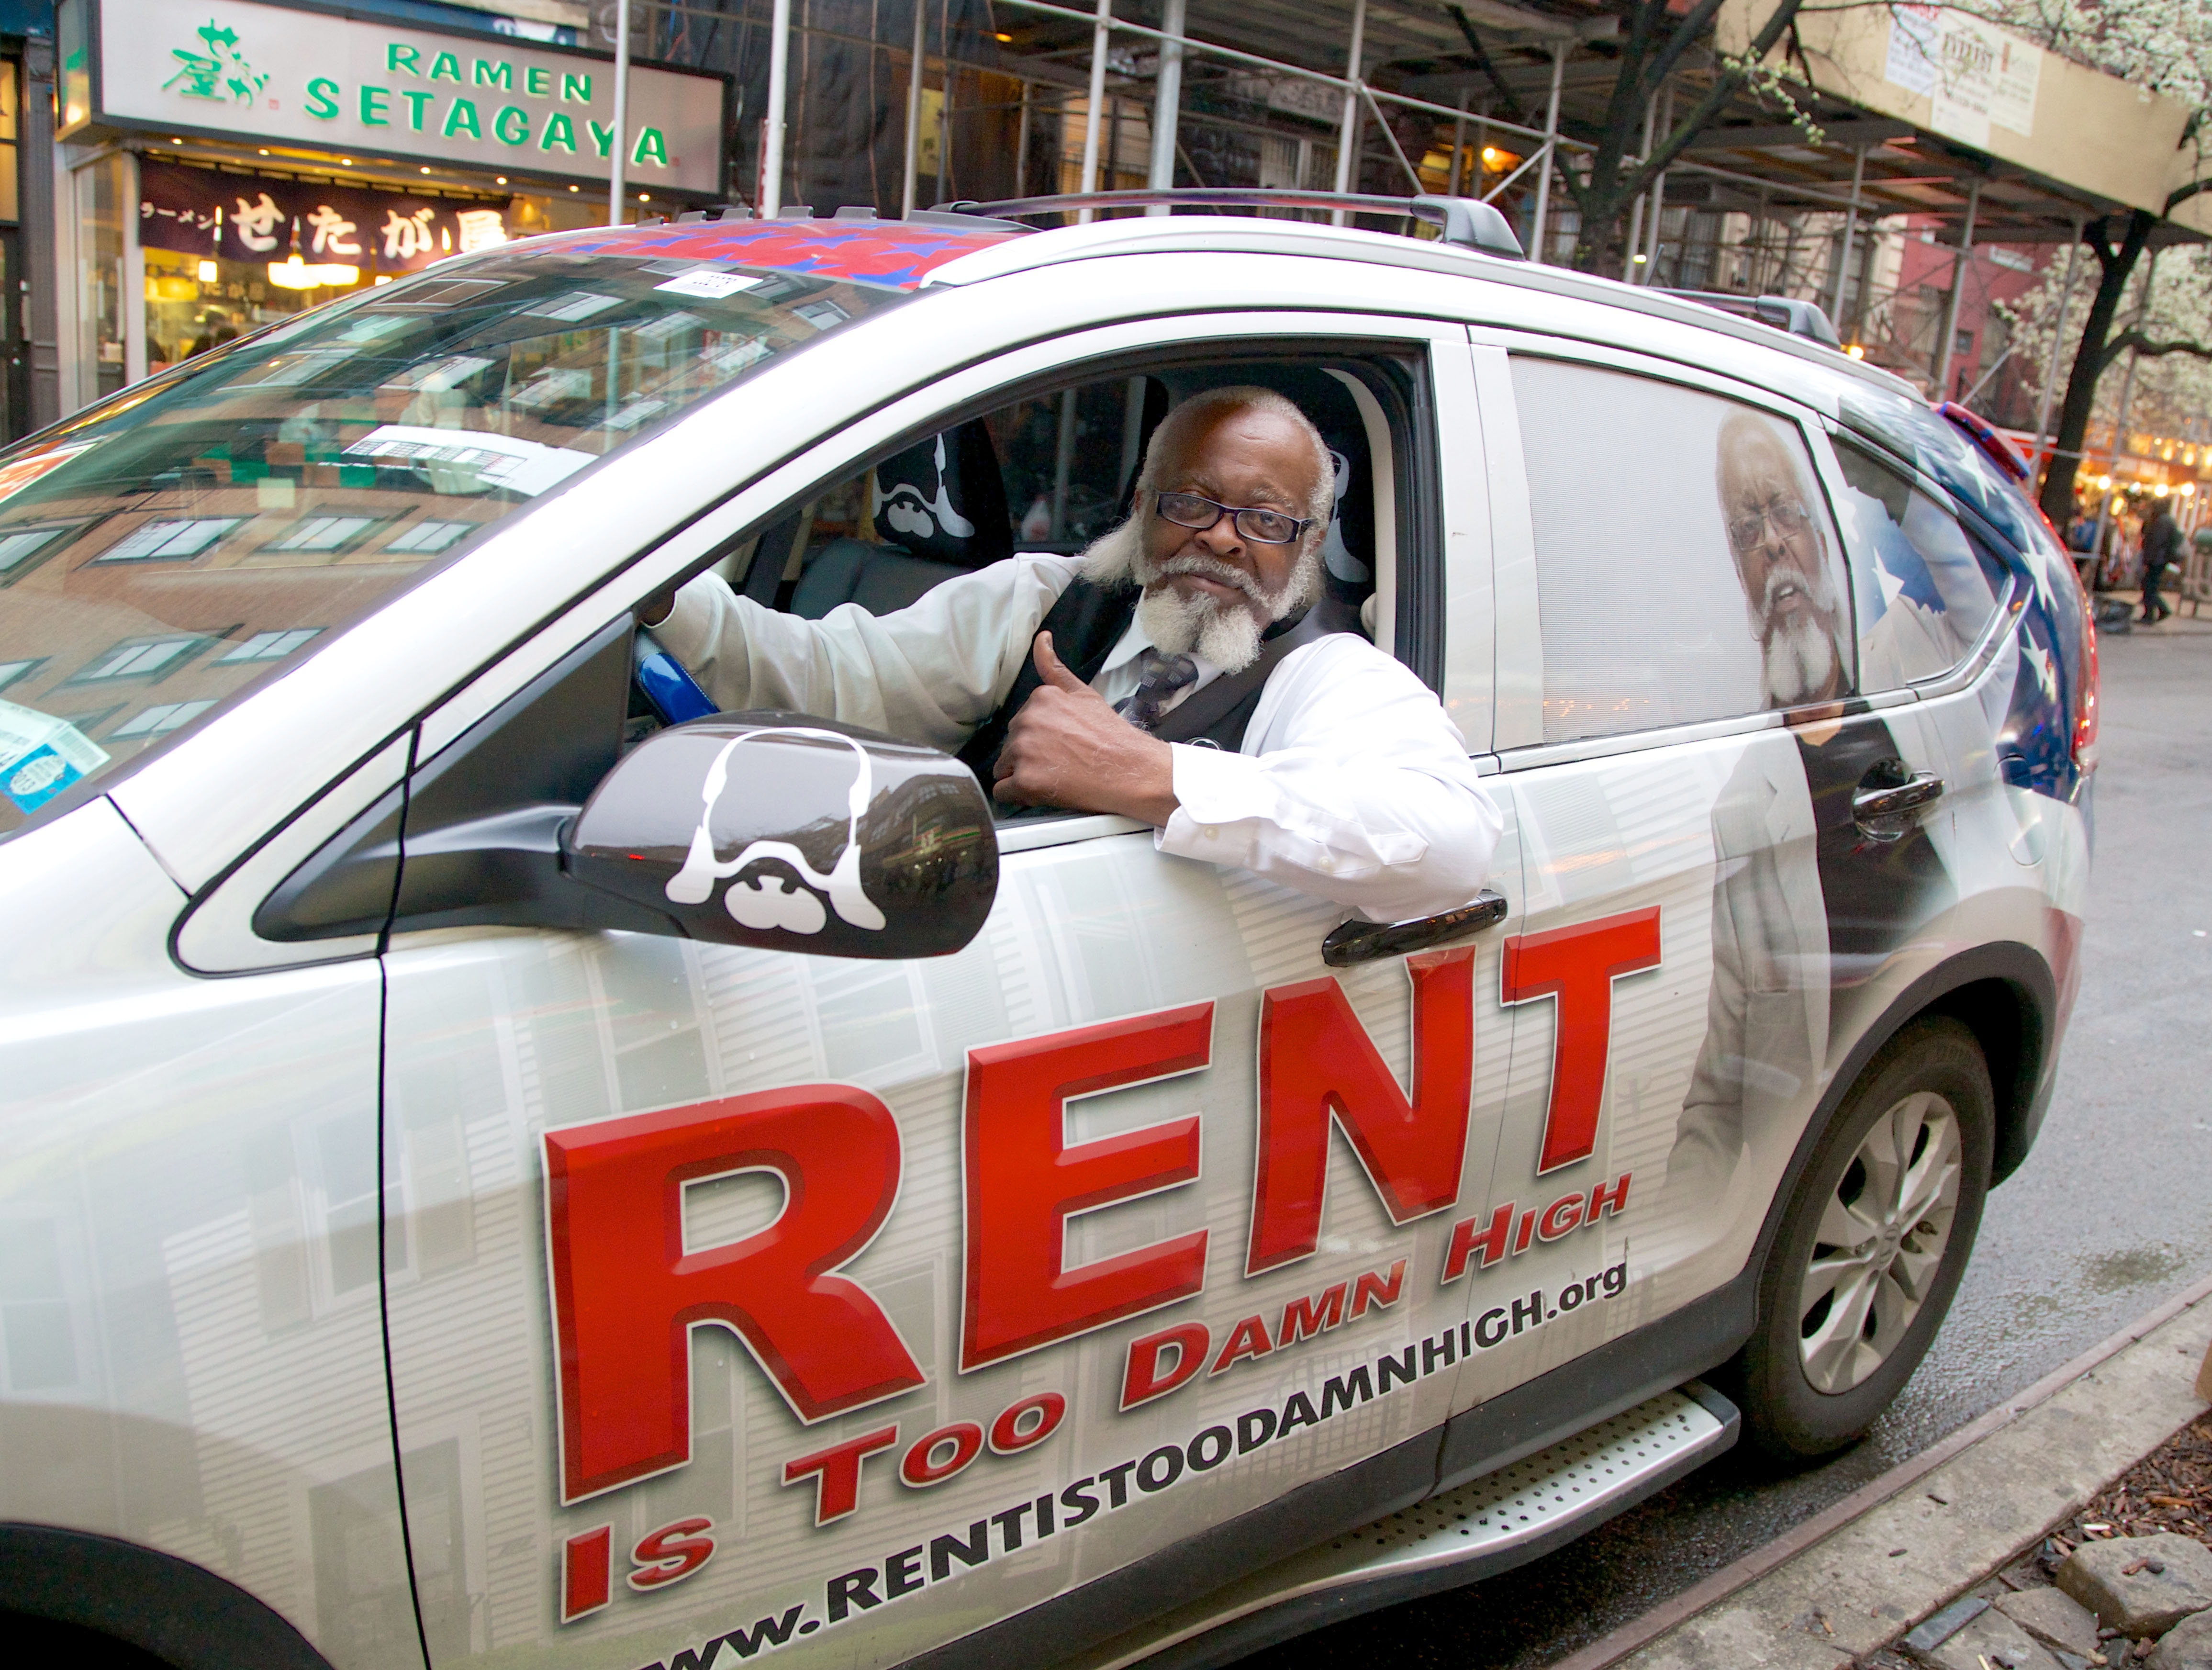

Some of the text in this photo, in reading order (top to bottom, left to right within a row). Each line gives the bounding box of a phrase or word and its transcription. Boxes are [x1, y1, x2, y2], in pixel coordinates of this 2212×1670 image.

[386, 43, 593, 104] RAMEN
[302, 77, 668, 167] SETAGAYA
[140, 201, 214, 230] ラーメン
[543, 903, 1663, 1503] RENT
[559, 1170, 1633, 1623] IS TOO DAMN HIGH
